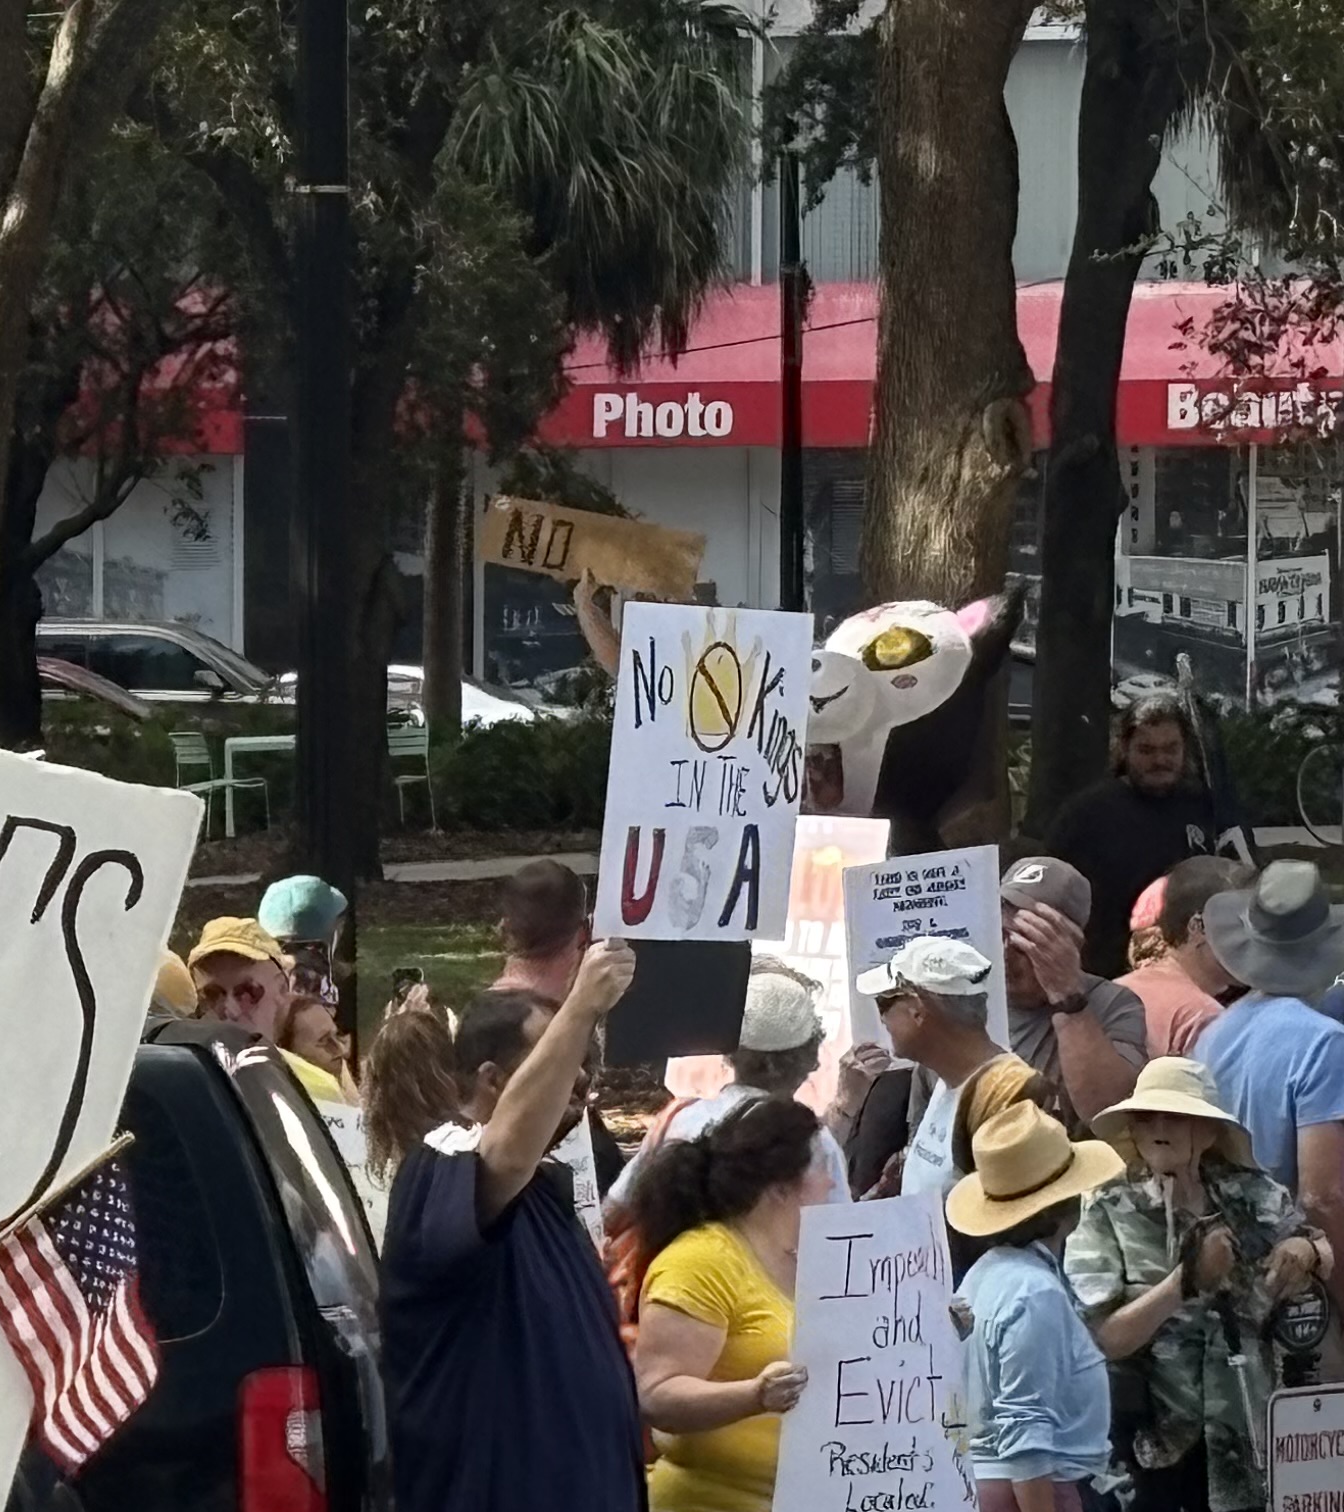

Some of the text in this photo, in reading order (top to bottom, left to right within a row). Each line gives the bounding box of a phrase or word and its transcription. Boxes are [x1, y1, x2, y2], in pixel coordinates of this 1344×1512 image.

[592, 392, 733, 438] Photo
[502, 508, 574, 571] NO
[632, 636, 674, 729] No
[665, 755, 750, 818] IN THE
[621, 824, 760, 931] USA
[872, 1289, 923, 1349] and
[835, 1344, 943, 1428] Evict
